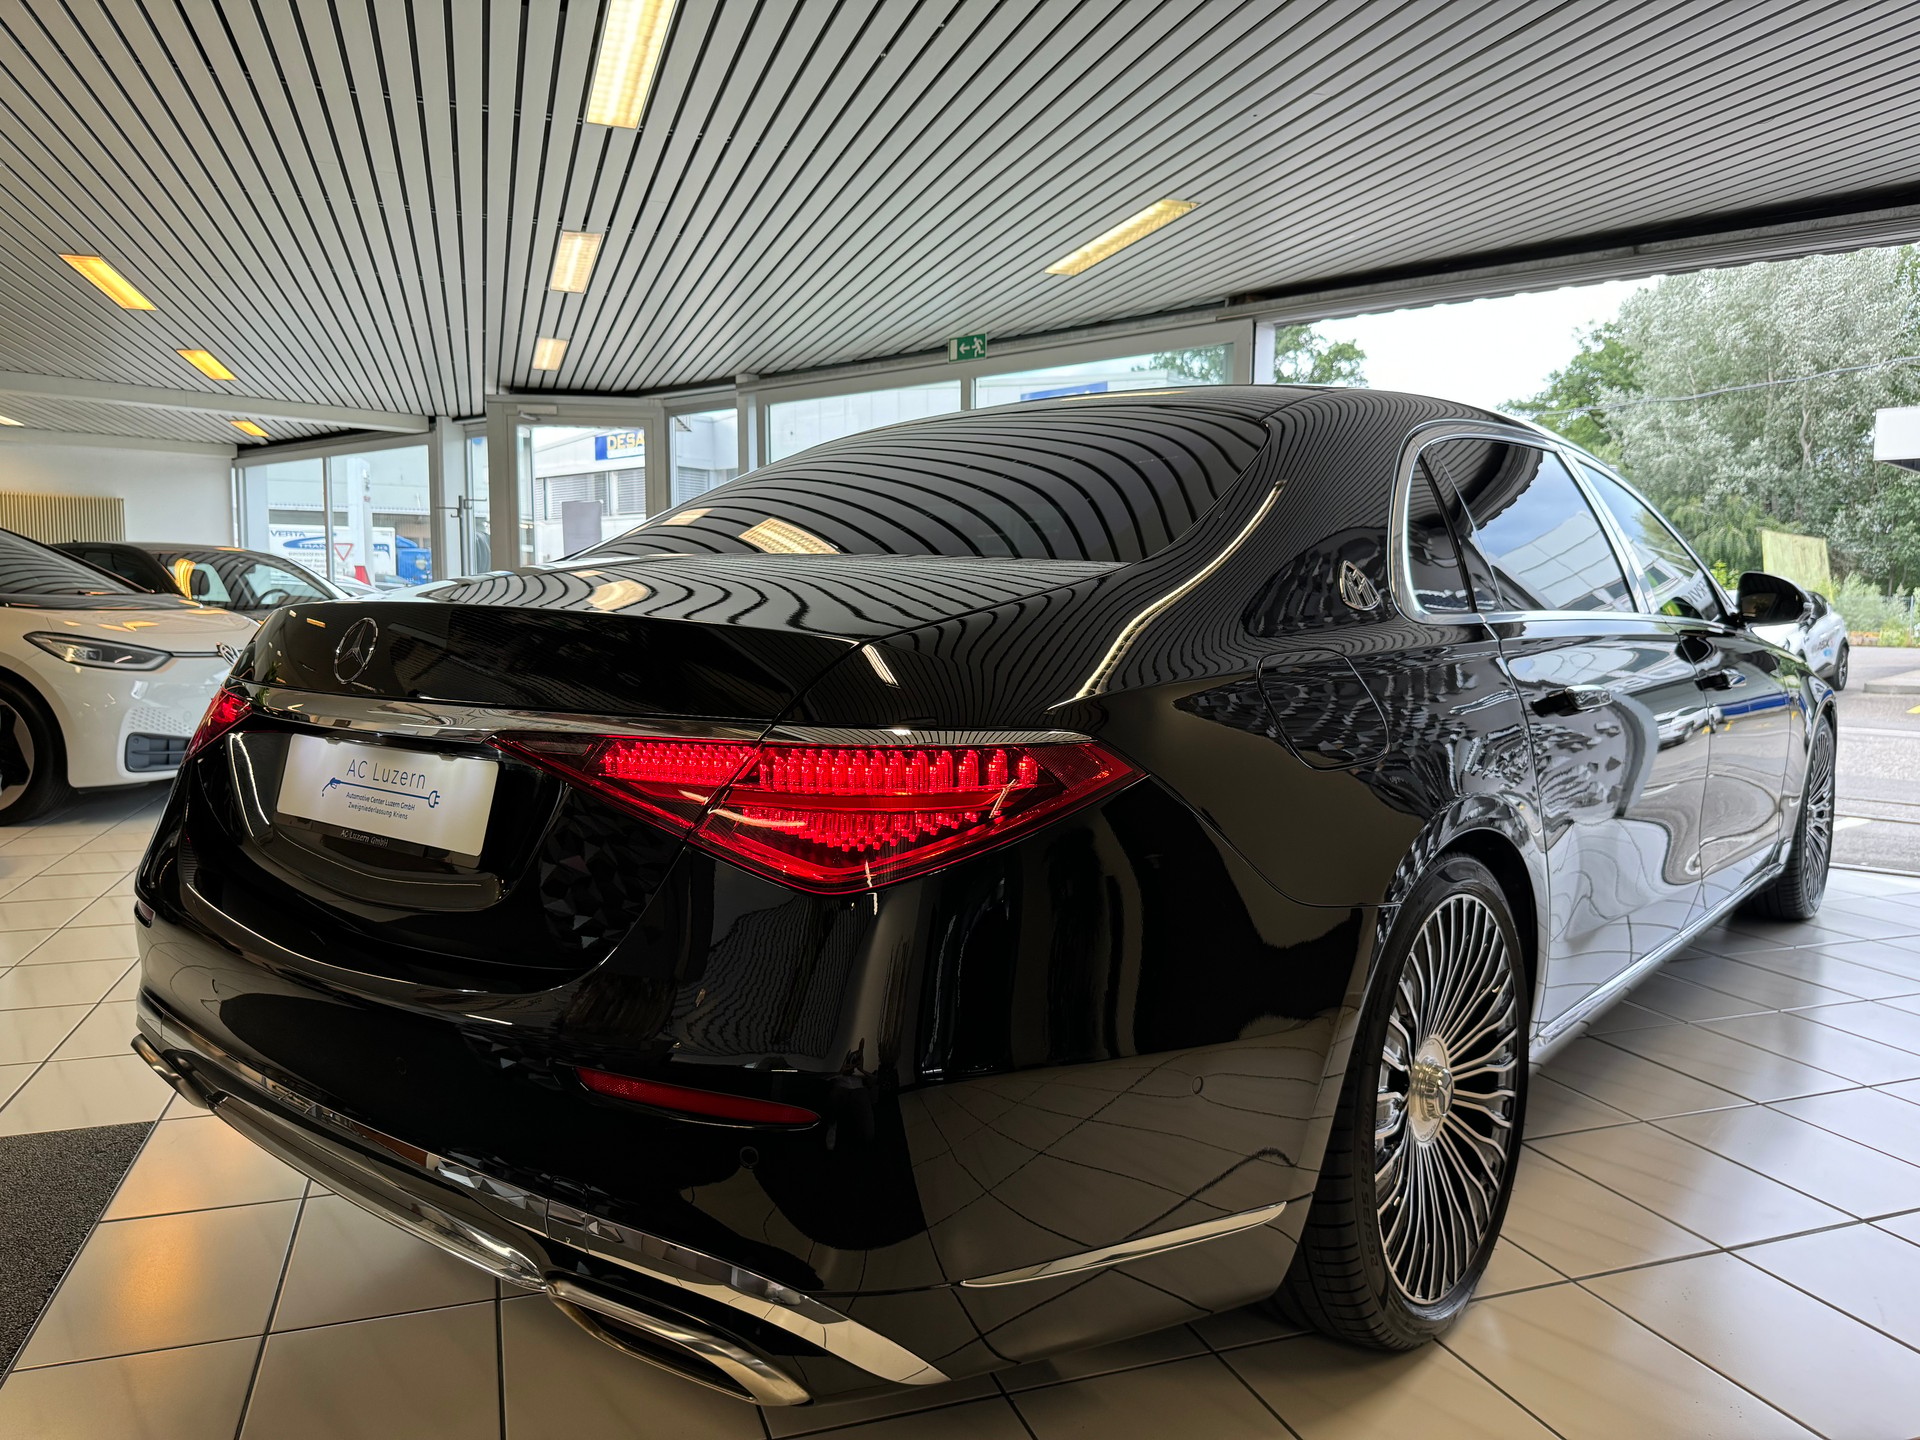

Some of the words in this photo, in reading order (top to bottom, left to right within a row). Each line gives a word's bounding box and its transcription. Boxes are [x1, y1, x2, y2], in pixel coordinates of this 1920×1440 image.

[270, 529, 306, 538] VERTA
[346, 759, 368, 779] AC
[372, 762, 426, 790] Luzern
[345, 792, 370, 803] Automotive
[370, 796, 385, 805] Center
[385, 800, 400, 809] Luzern
[400, 802, 416, 811] GmbH
[348, 802, 392, 818] Zweigniederlassung
[392, 811, 408, 820] Kriens
[340, 829, 349, 838] AC
[349, 831, 370, 843] Luzern
[370, 836, 390, 848] GmbH
